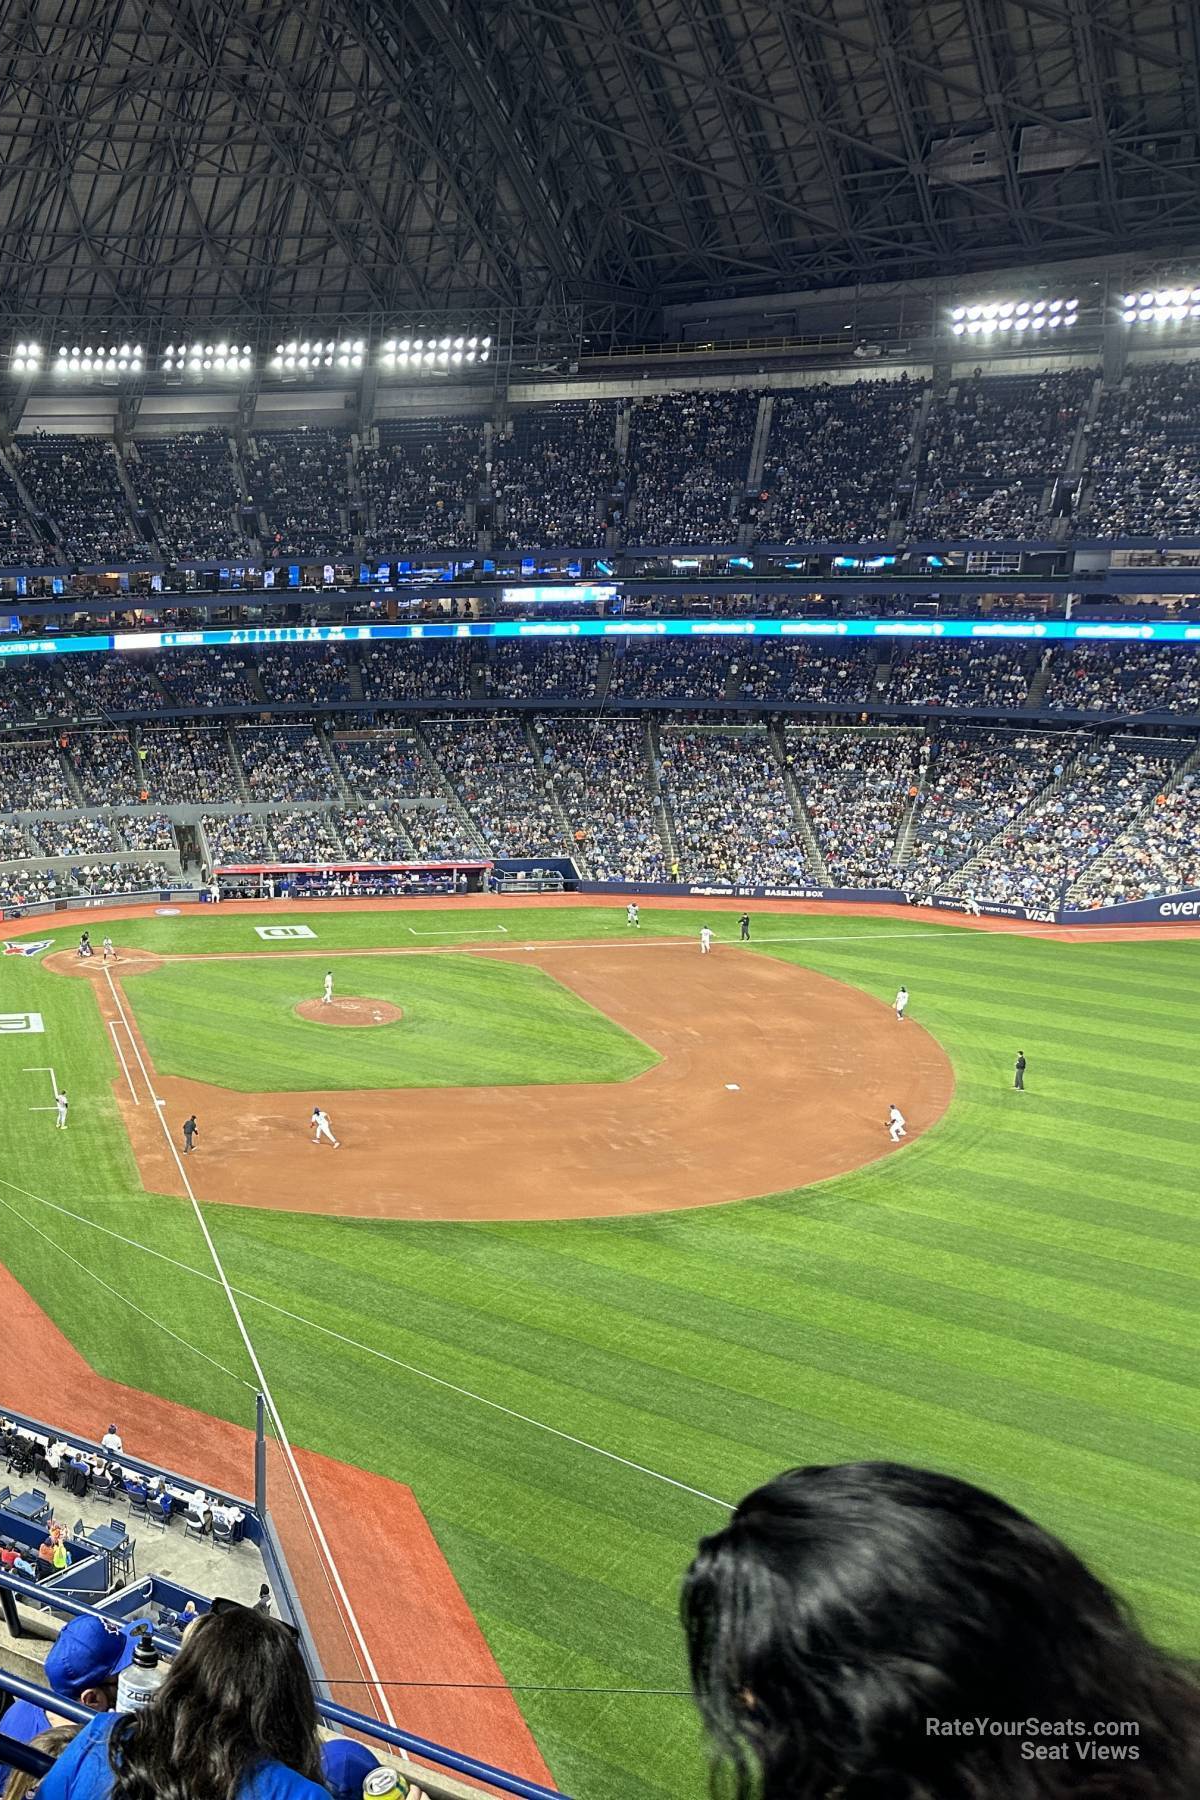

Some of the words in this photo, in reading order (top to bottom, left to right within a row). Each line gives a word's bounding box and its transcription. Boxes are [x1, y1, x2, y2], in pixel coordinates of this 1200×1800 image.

[739, 887, 756, 896] BET
[765, 889, 804, 898] BASELINE
[806, 890, 824, 898] BOX
[904, 892, 933, 906] VA
[985, 905, 1001, 913] want
[1023, 908, 1056, 923] VISA
[1159, 902, 1200, 918] ever
